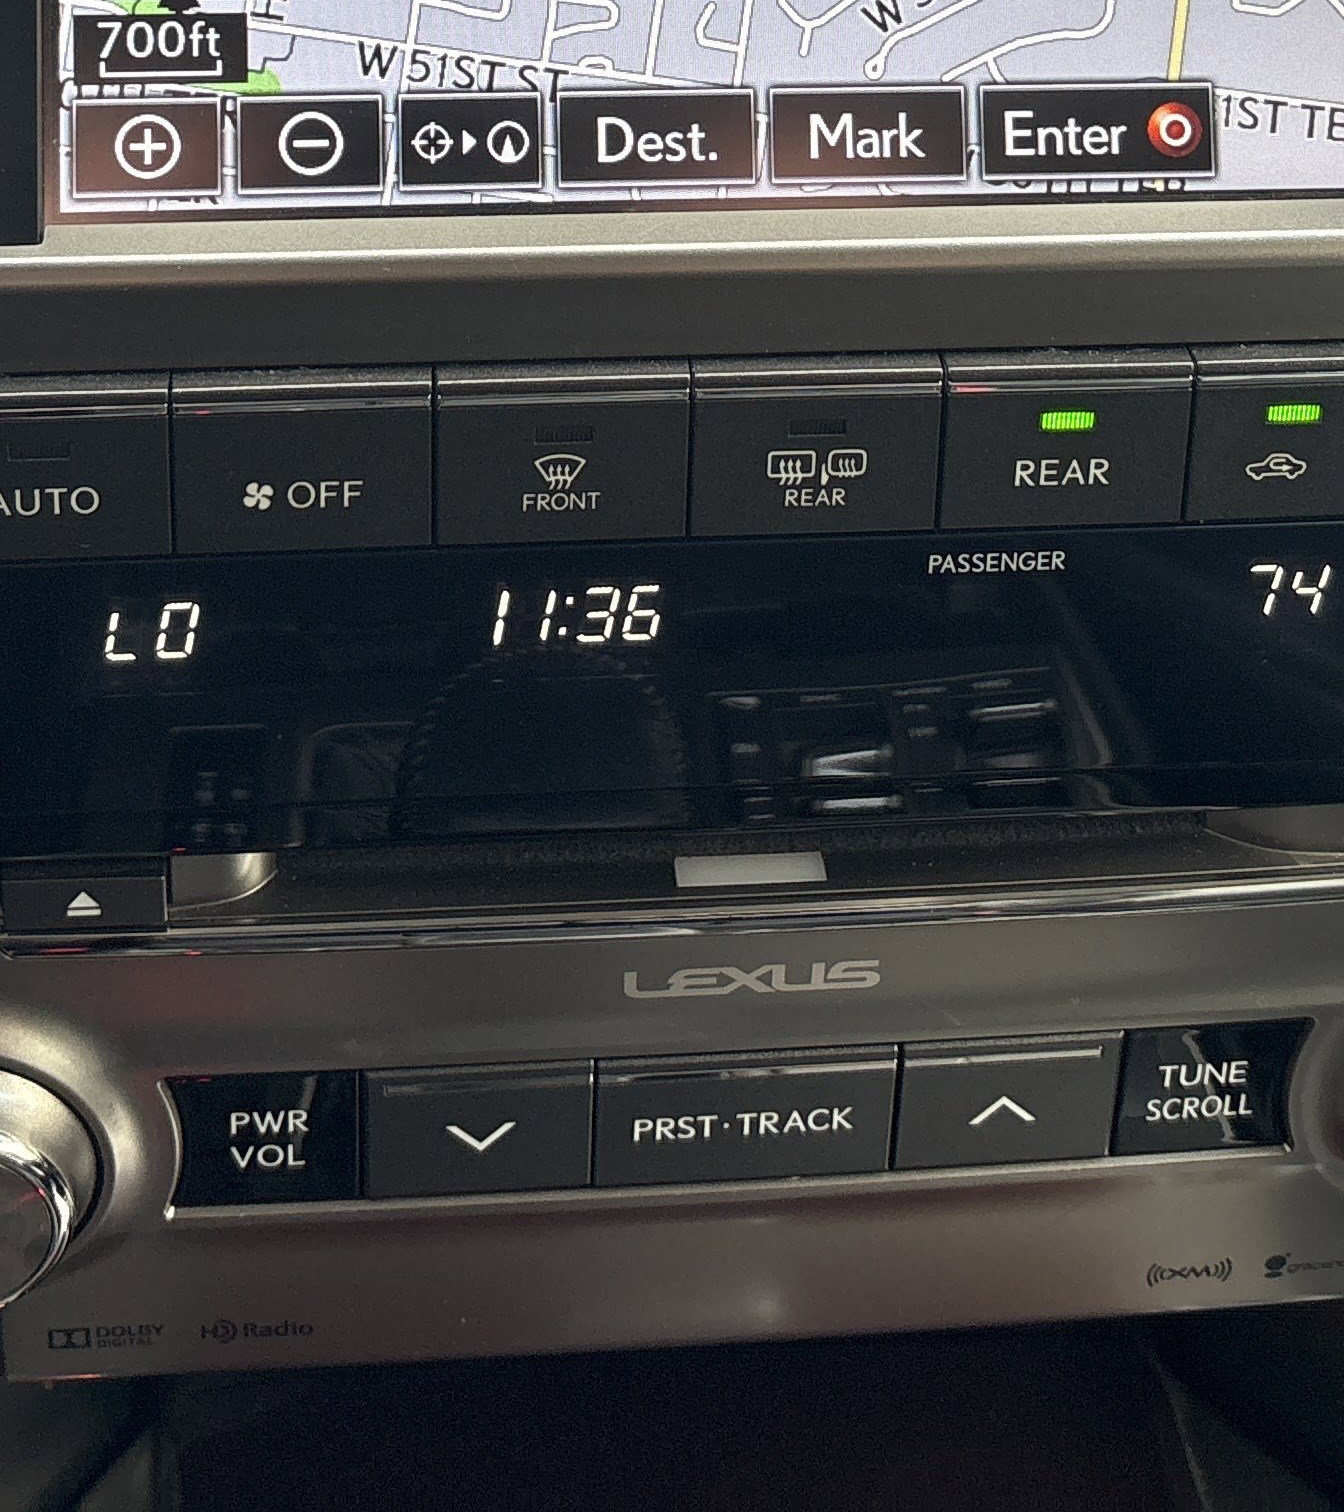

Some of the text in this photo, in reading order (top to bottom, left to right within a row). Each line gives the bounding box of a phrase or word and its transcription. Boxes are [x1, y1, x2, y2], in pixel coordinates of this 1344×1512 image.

[97, 21, 222, 59] 700ft
[360, 42, 569, 103] W 51ST ST
[597, 115, 719, 163] Dest.
[810, 111, 926, 161] Mark
[1003, 110, 1127, 156] Enter
[1014, 457, 1111, 488] REAR
[287, 479, 364, 510] OFF
[522, 491, 602, 513] FRONT
[784, 488, 847, 508] REAR
[927, 550, 1067, 575] PASSENGER
[1250, 564, 1333, 616] 74
[491, 584, 661, 647] 11:36
[624, 959, 881, 999] LEXUS
[1159, 1060, 1249, 1088] TUNE
[230, 1109, 309, 1136] PWR
[1146, 1094, 1253, 1122] SCROLL
[231, 1144, 306, 1168] VOL
[95, 1323, 166, 1338] DOLBY
[243, 1318, 315, 1338] Radio
